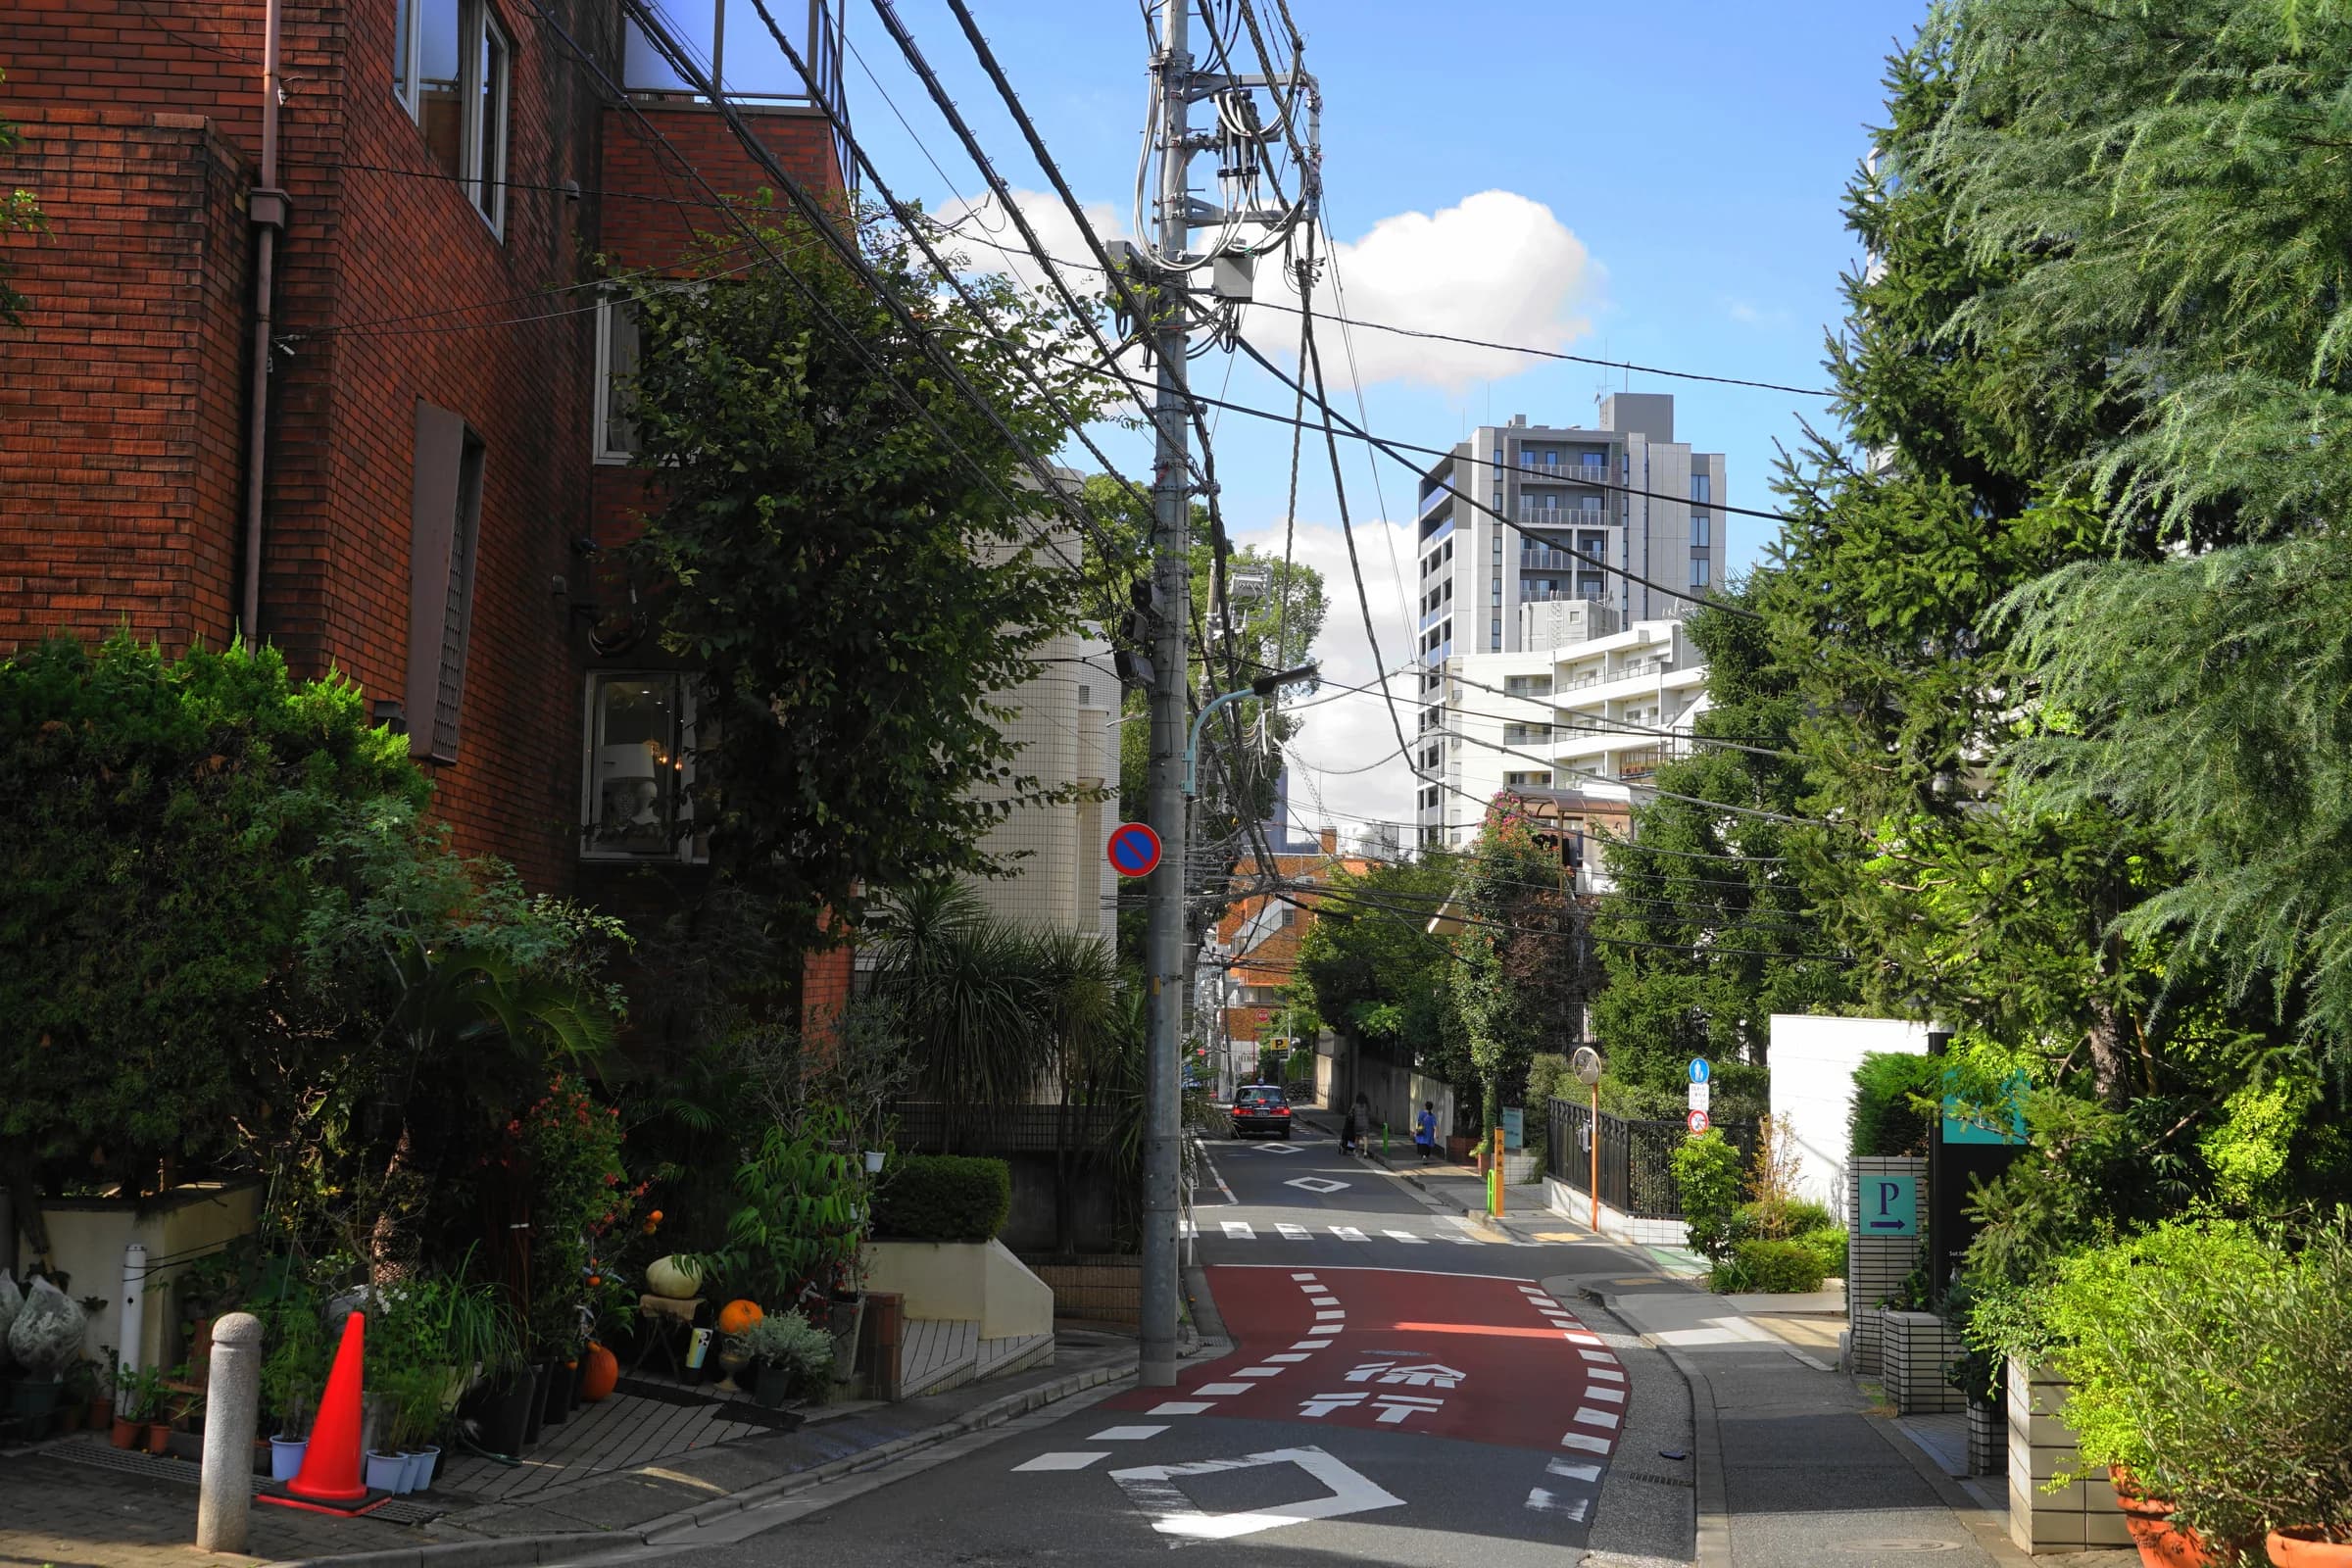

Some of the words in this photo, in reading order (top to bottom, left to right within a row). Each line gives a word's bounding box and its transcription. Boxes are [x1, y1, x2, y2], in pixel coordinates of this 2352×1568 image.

[1275, 1039, 1284, 1049] P
[1877, 1182, 1899, 1216] P
[1298, 1361, 1466, 1424] 徐行
